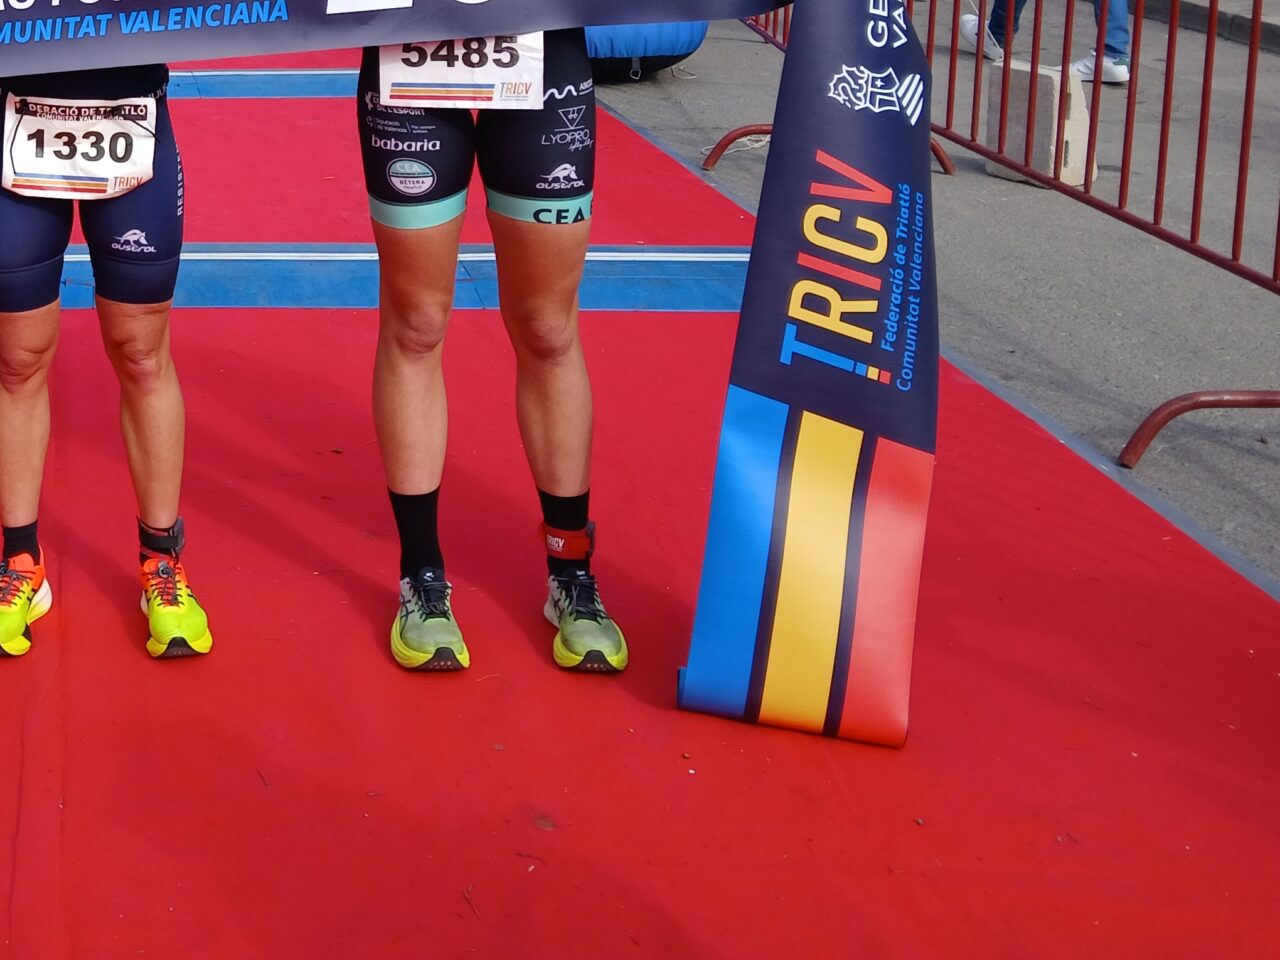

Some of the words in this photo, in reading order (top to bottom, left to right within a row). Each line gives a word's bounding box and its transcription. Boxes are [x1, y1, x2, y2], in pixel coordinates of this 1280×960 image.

[118, 0, 289, 35] VALENCIANA
[401, 36, 520, 68] 5485
[500, 82, 532, 98] TRICV
[81, 107, 96, 116] DE
[27, 129, 133, 163] 1330
[372, 133, 441, 152] babaria
[541, 129, 590, 144] LYOPRO
[533, 207, 584, 224] CEA
[896, 183, 911, 238] Triatló
[895, 244, 907, 266] de
[908, 192, 924, 290] Valenciana
[780, 149, 893, 384] TRICV
[881, 270, 906, 352] Federació
[897, 294, 921, 392] Comunitat
